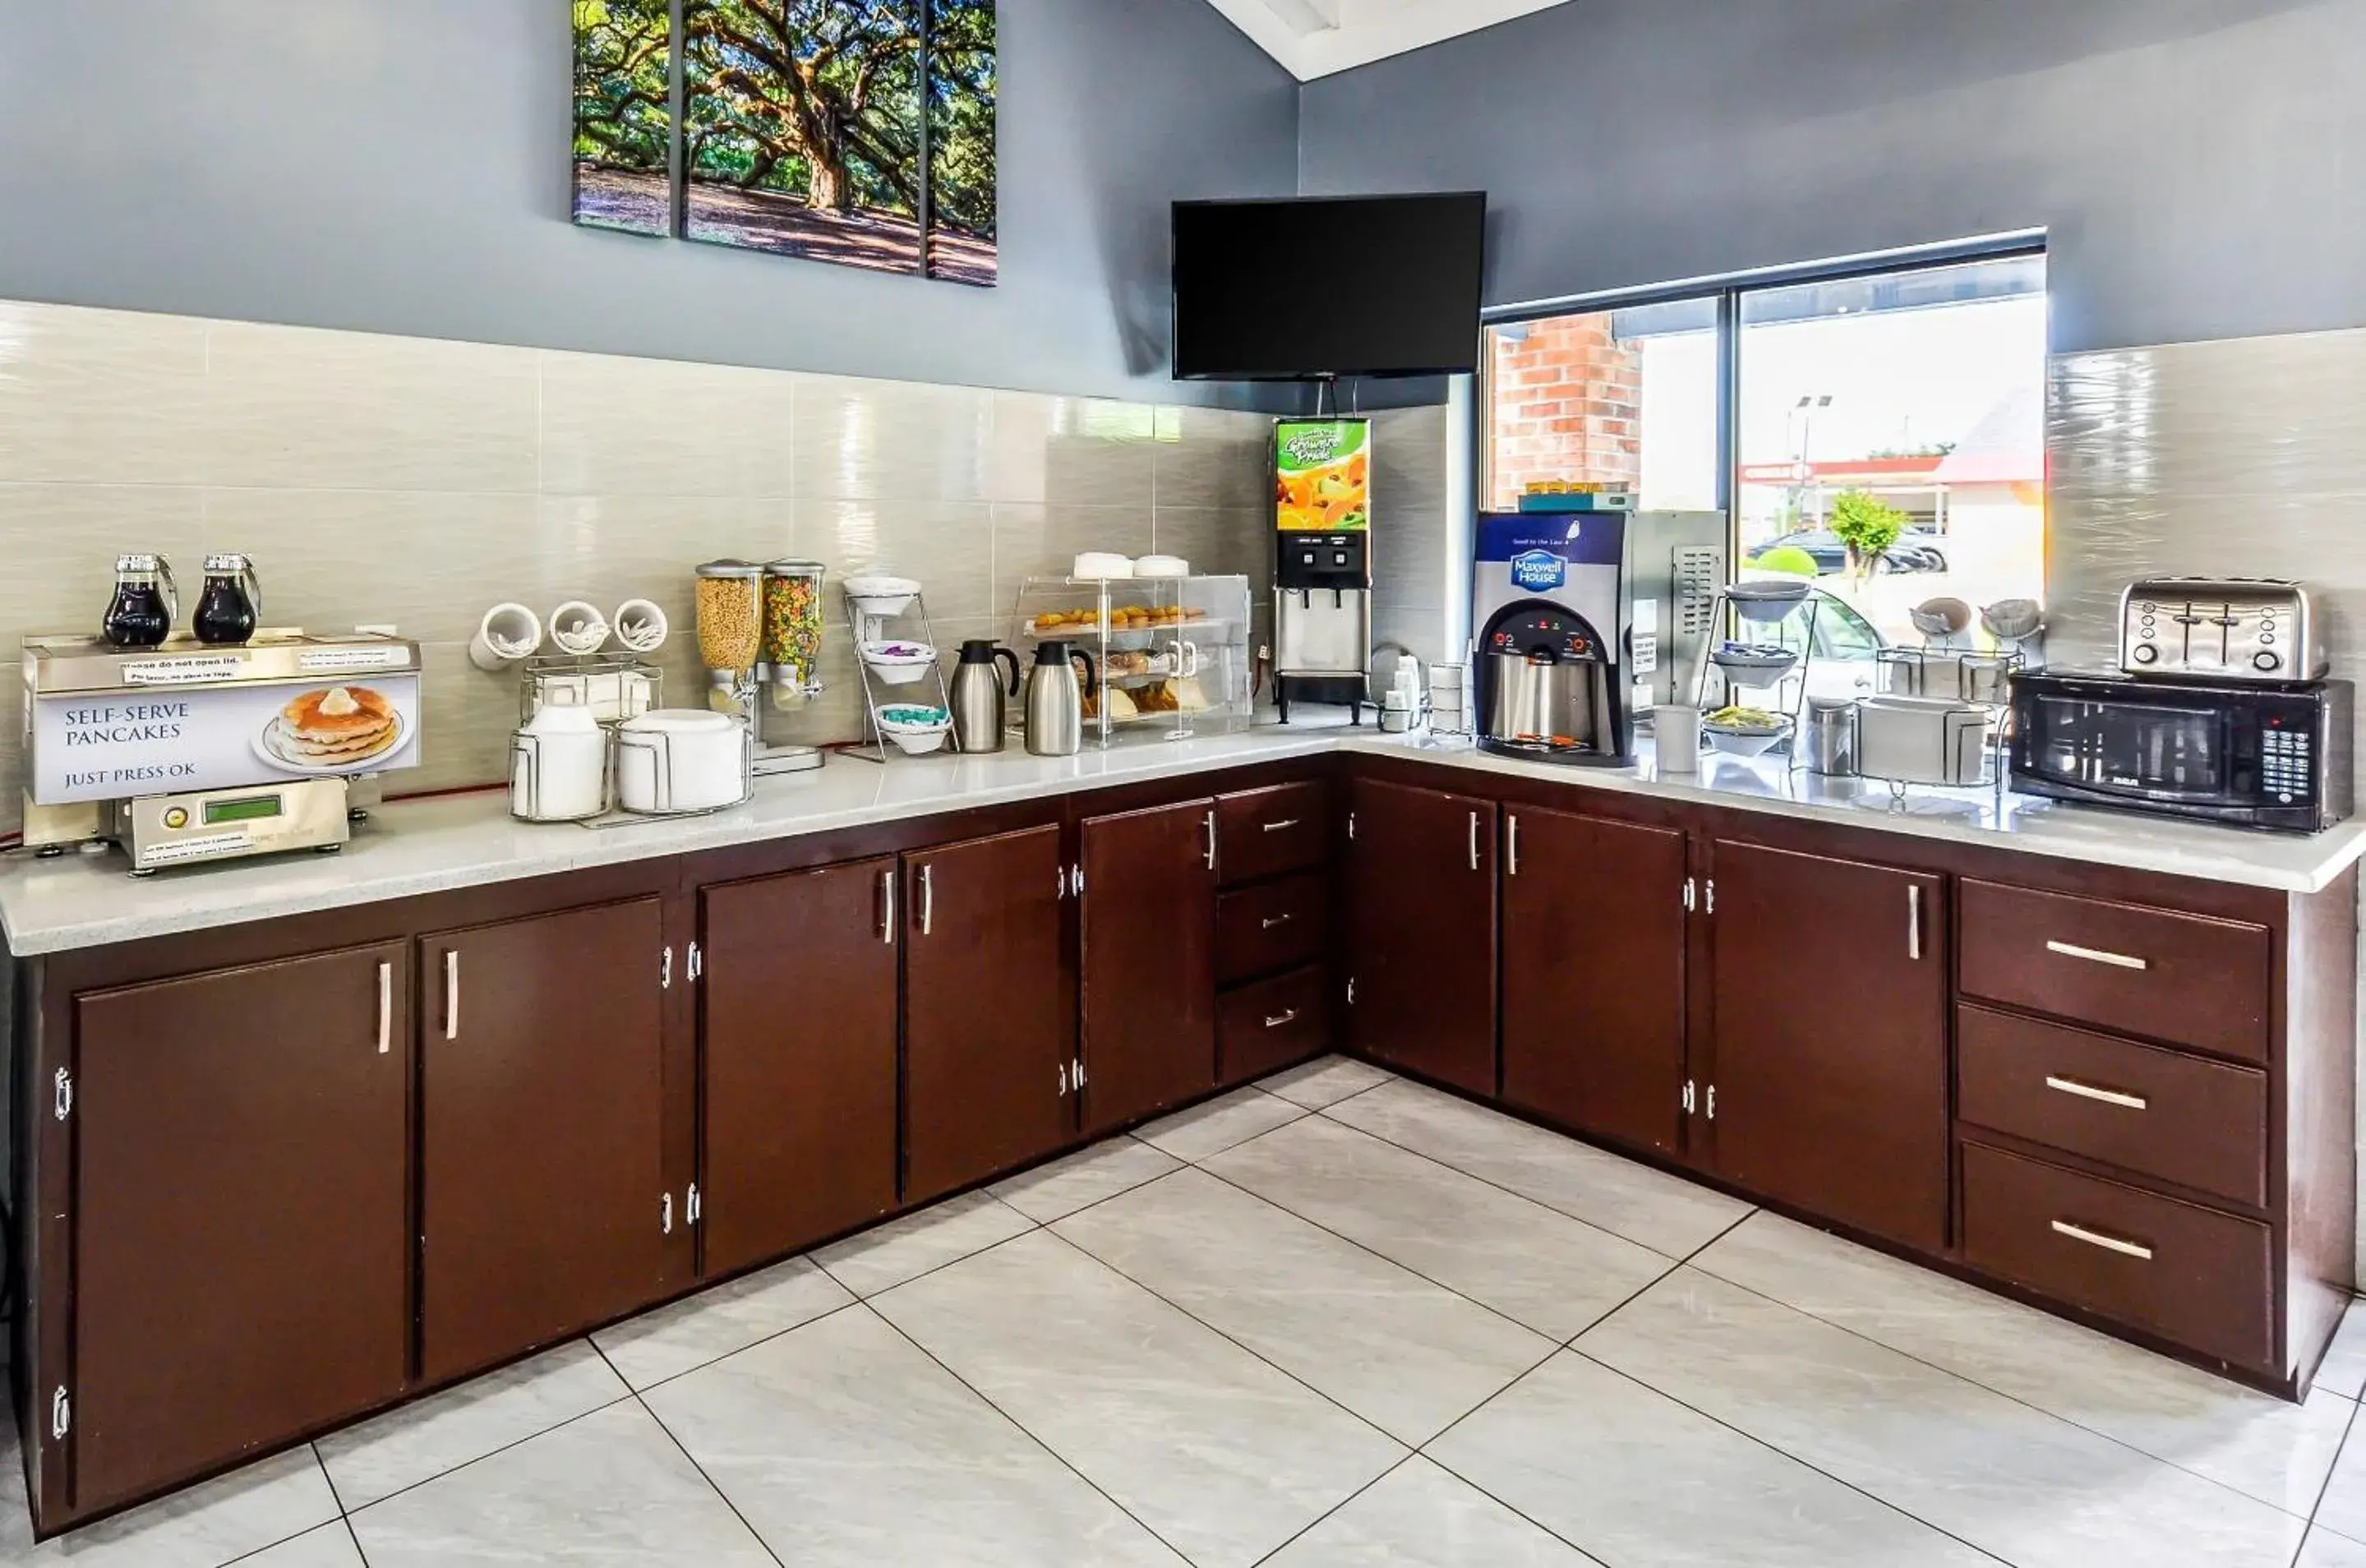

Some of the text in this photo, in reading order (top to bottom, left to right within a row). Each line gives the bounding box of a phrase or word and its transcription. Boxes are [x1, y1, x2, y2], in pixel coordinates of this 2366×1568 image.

[1515, 560, 1561, 573] Maxwell
[1519, 571, 1557, 583] House
[175, 659, 191, 667] not
[195, 659, 220, 667] open
[66, 703, 189, 726] SELF-SERVE
[66, 723, 181, 745] PANCAKES
[66, 763, 196, 789] JUST PRESS OK
